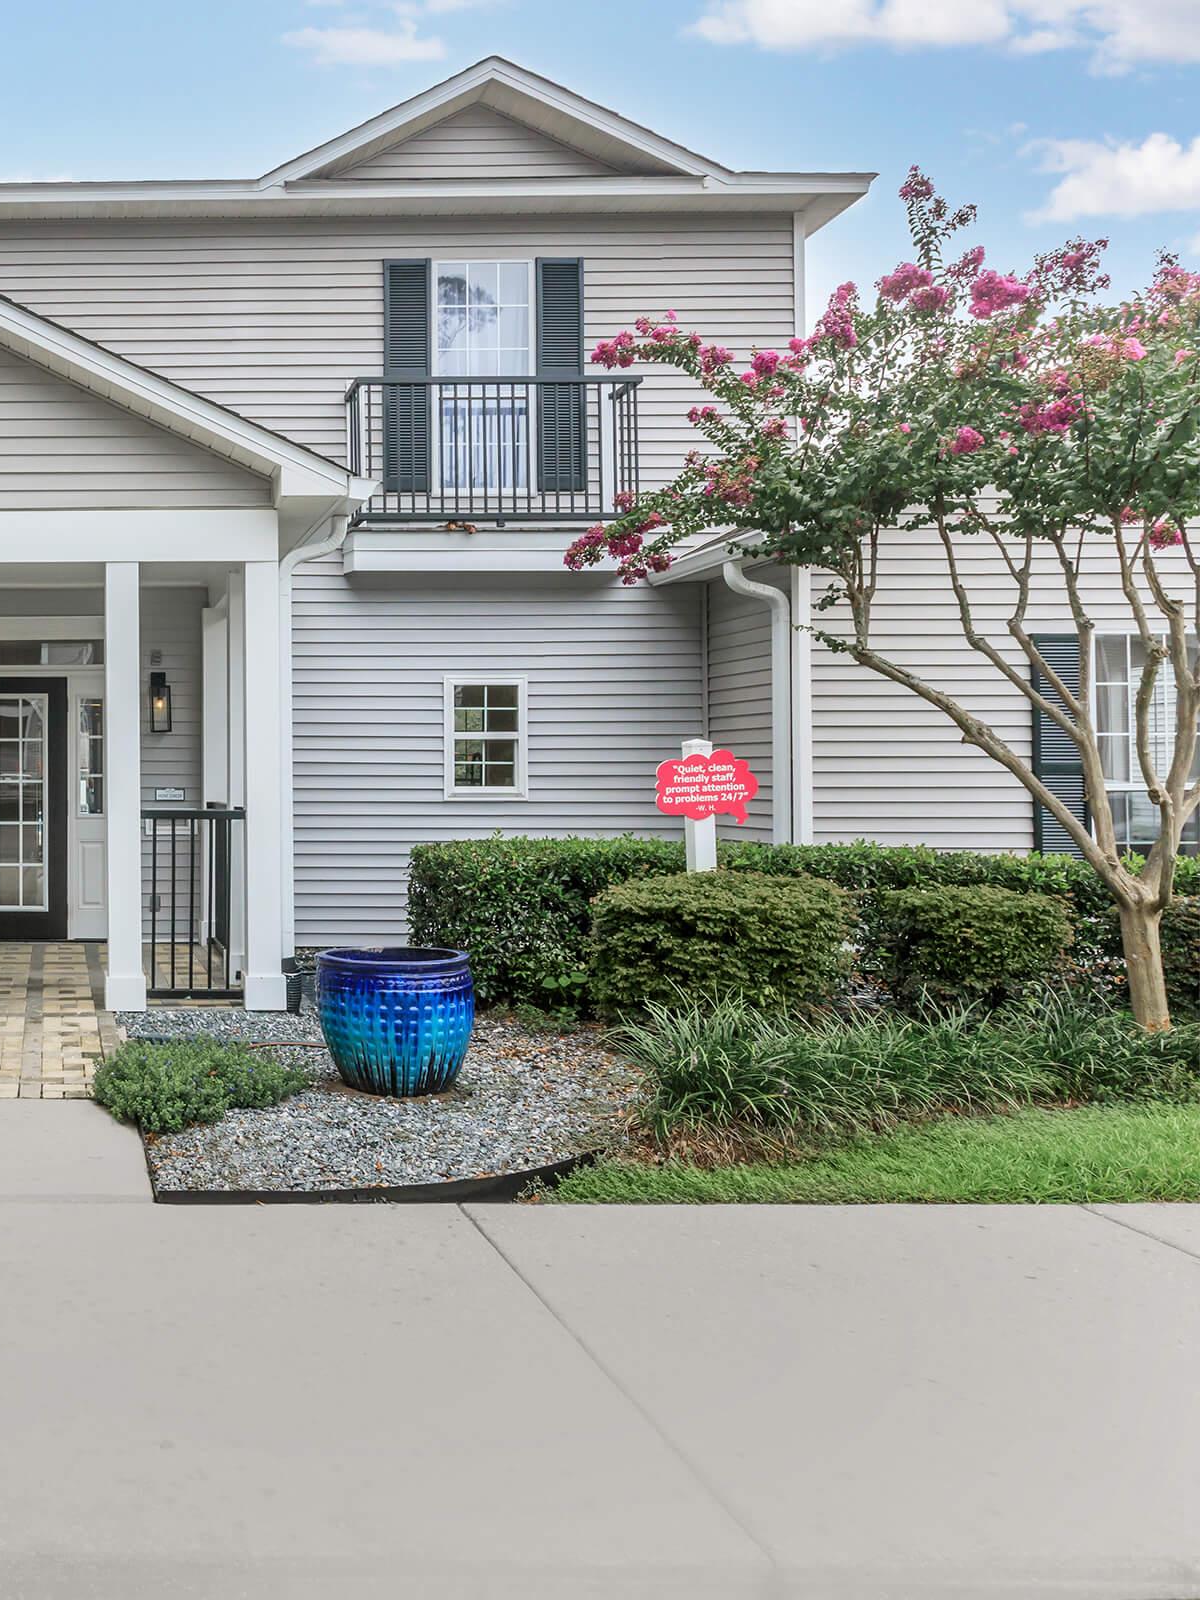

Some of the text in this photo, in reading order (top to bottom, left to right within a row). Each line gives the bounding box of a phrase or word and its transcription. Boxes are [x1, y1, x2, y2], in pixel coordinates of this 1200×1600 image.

[708, 764, 736, 772] clean,
[673, 774, 736, 784] friendly staff,
[666, 783, 744, 794] prompt attention
[675, 794, 718, 804] problems
[720, 792, 748, 802] 24/7"
